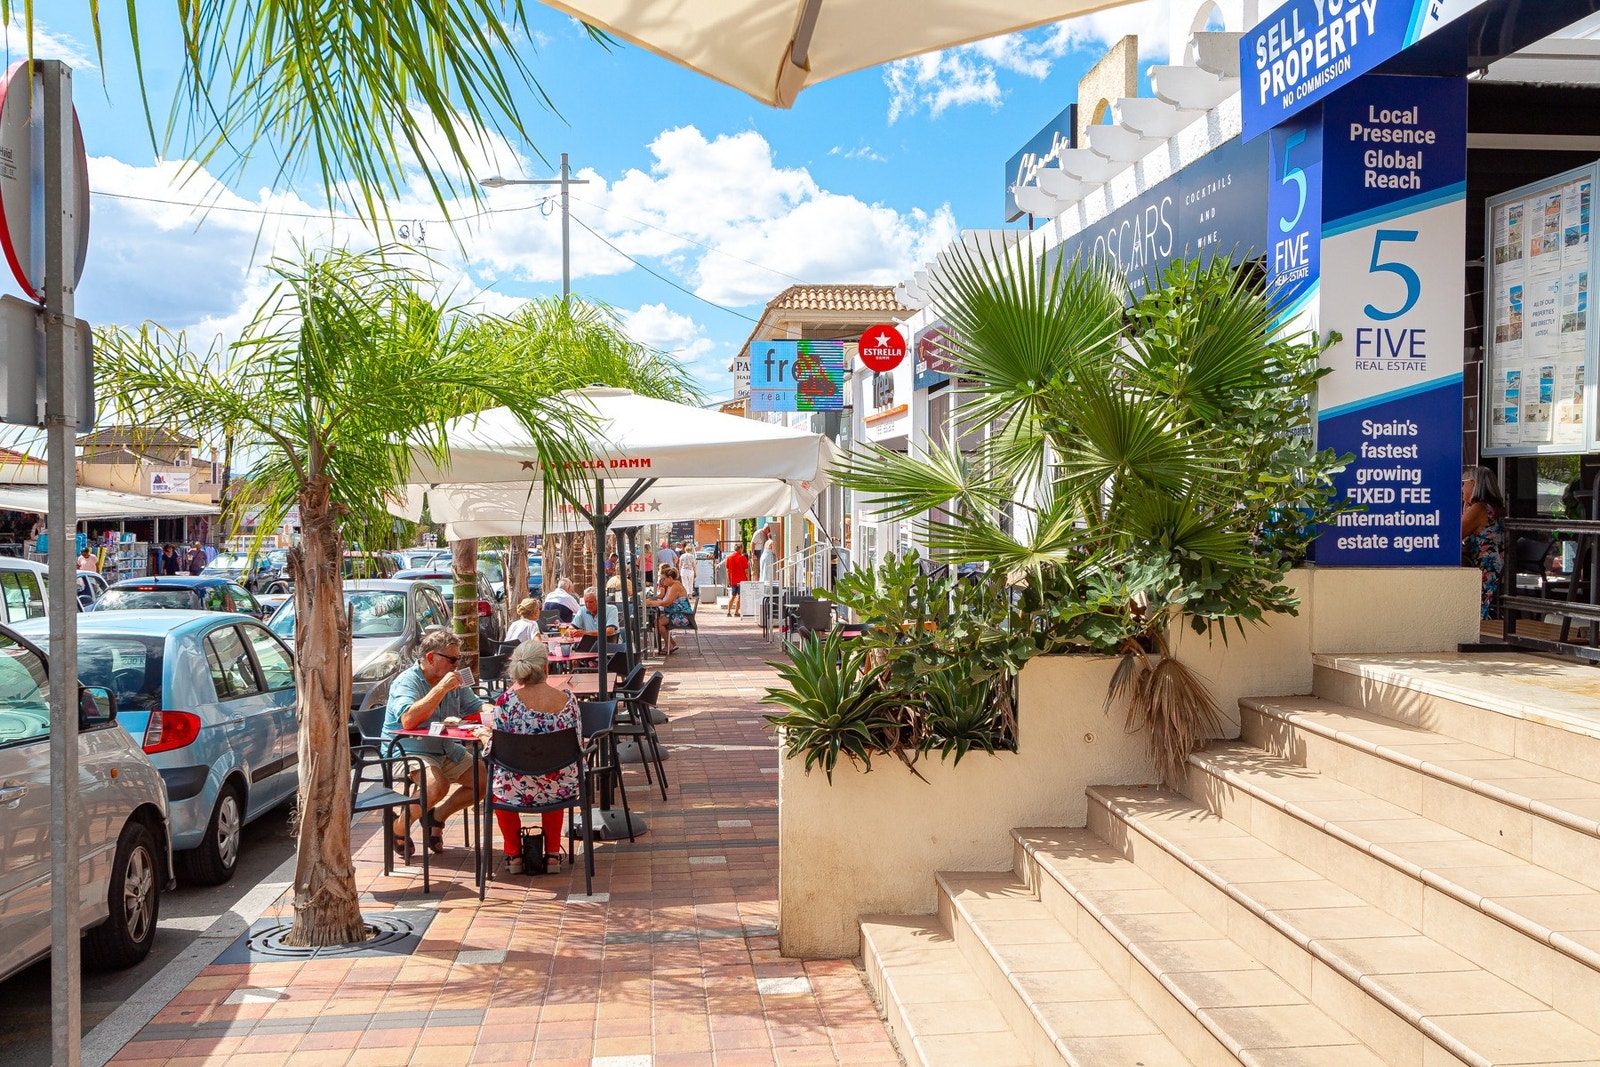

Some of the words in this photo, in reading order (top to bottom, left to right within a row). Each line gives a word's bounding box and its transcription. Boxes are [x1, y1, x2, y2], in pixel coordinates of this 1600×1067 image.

[1256, 8, 1305, 70] SELL
[1260, 0, 1379, 105] PROPERTY
[1282, 91, 1294, 109] NO
[1296, 55, 1351, 101] COMMISSION
[1369, 105, 1418, 125] Local
[1350, 124, 1436, 145] Presence
[1364, 150, 1422, 170] Global
[1185, 174, 1232, 206] COCKTAILS
[1279, 129, 1308, 234] 5
[1364, 171, 1421, 190] Reach
[1200, 207, 1216, 224] AND
[1092, 196, 1173, 283] OSCARS
[1197, 231, 1218, 249] WINE
[1275, 231, 1309, 274] FIVE
[1363, 229, 1421, 321] 5
[863, 347, 902, 357] ESTRELLA
[1356, 328, 1426, 358] FIVE
[1355, 361, 1384, 371] REAL
[1387, 361, 1427, 371] ESTATE
[761, 391, 786, 401] real
[1361, 420, 1418, 439] Spain's
[1361, 442, 1418, 459] fastest
[609, 458, 652, 469] DAMM
[1356, 465, 1422, 485] growing
[1347, 488, 1395, 504] FIXED
[1401, 488, 1431, 503] FEE
[1337, 510, 1440, 527] international
[1337, 534, 1389, 550] estate
[1393, 534, 1440, 552] agent
